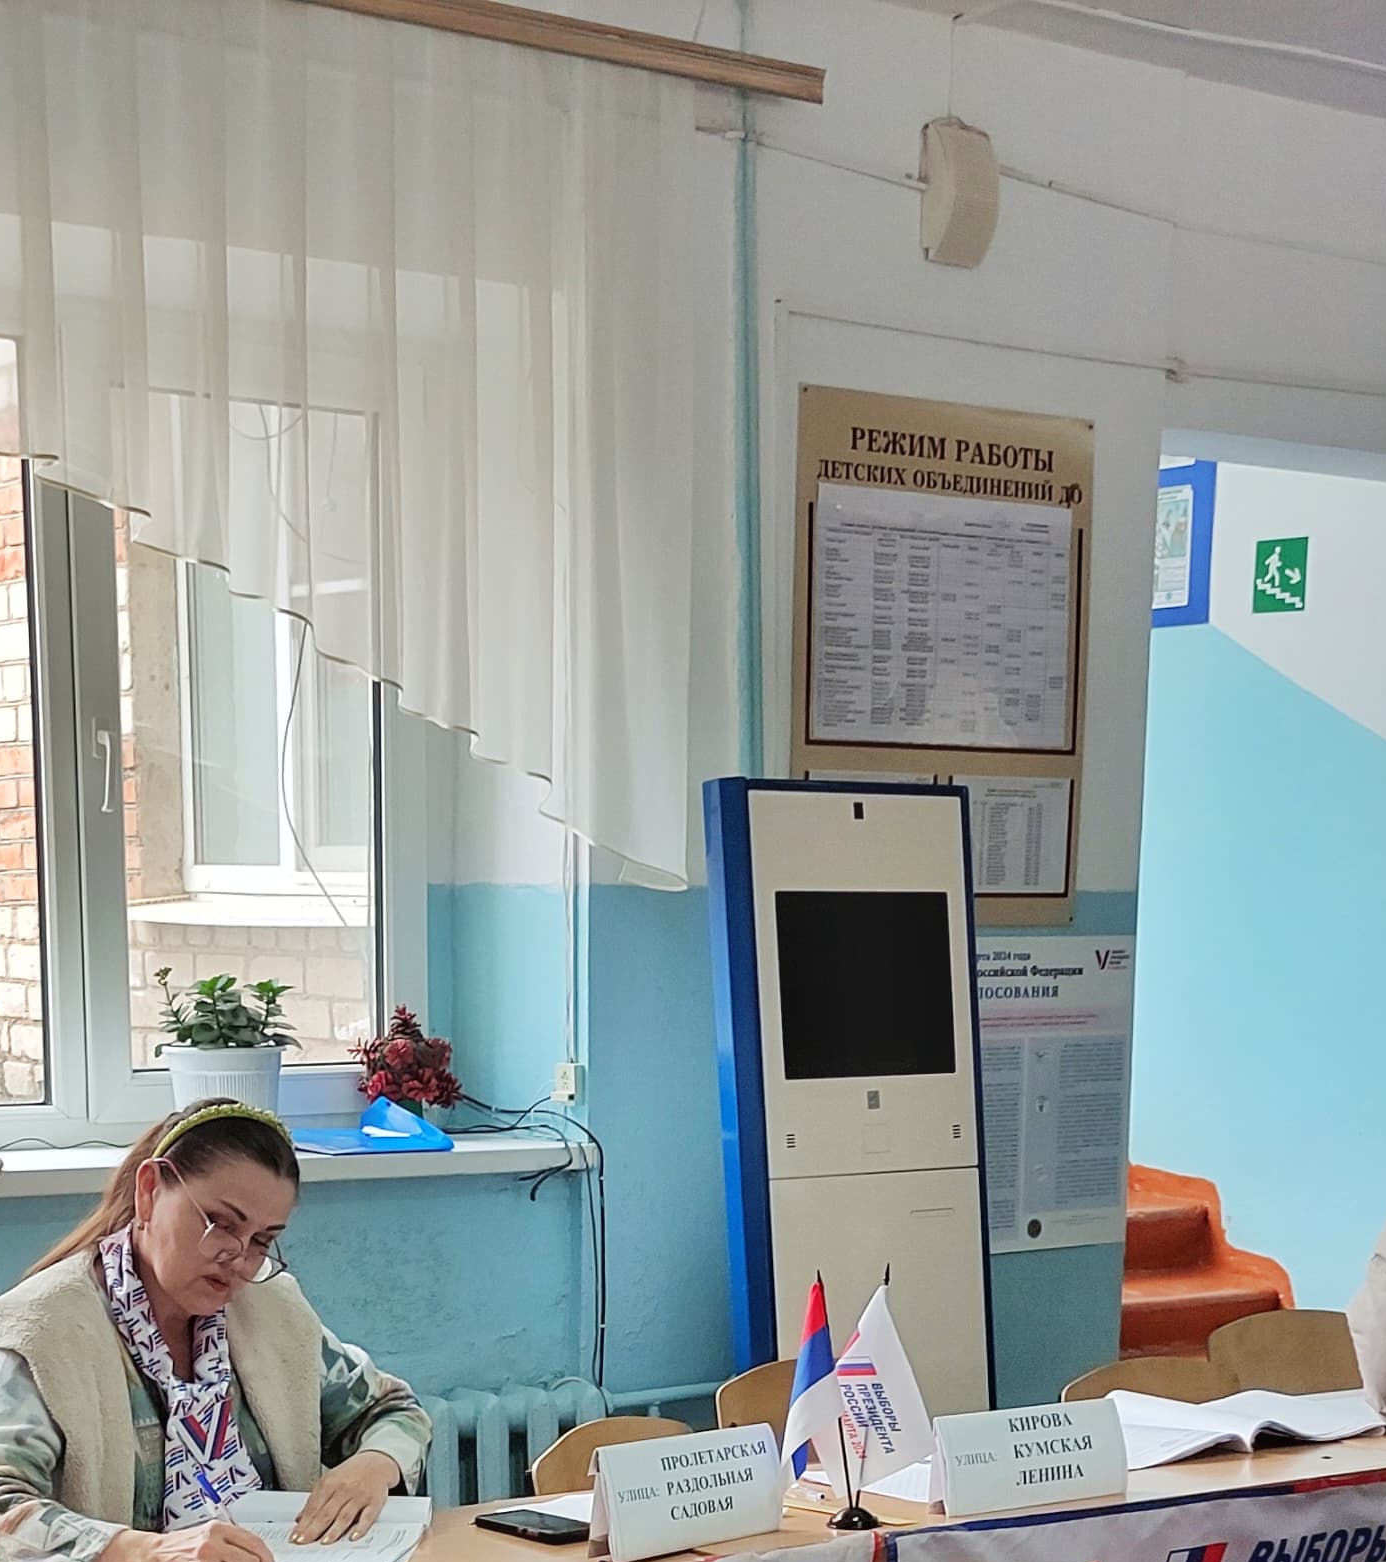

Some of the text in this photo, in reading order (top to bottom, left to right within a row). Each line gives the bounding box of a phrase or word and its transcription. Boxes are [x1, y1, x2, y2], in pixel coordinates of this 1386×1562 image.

[850, 427, 1054, 473] РЕЖИМ РАБОТЫ
[817, 459, 906, 486] ДЕТСКИХ
[913, 468, 1053, 501] ОБЪЕДИНЕНИЙ
[976, 964, 1028, 978] оссийской
[839, 1384, 869, 1427] РОССИИ
[855, 1384, 895, 1454] ПРЕЗИДЕНТА
[871, 1383, 901, 1432] ВЫБОРЫ
[1008, 1412, 1073, 1433] КИРОВА
[660, 1440, 767, 1472] ПРОЛЕТАРСКАЯ
[955, 1435, 1093, 1467] УЛИЦА: КУМСКАЯ
[617, 1467, 754, 1504] УЛИЦА: РАЗДОЛЬНАЯ
[1015, 1463, 1085, 1486] ЛЕНИНА
[670, 1496, 734, 1521] САДОВАЯ
